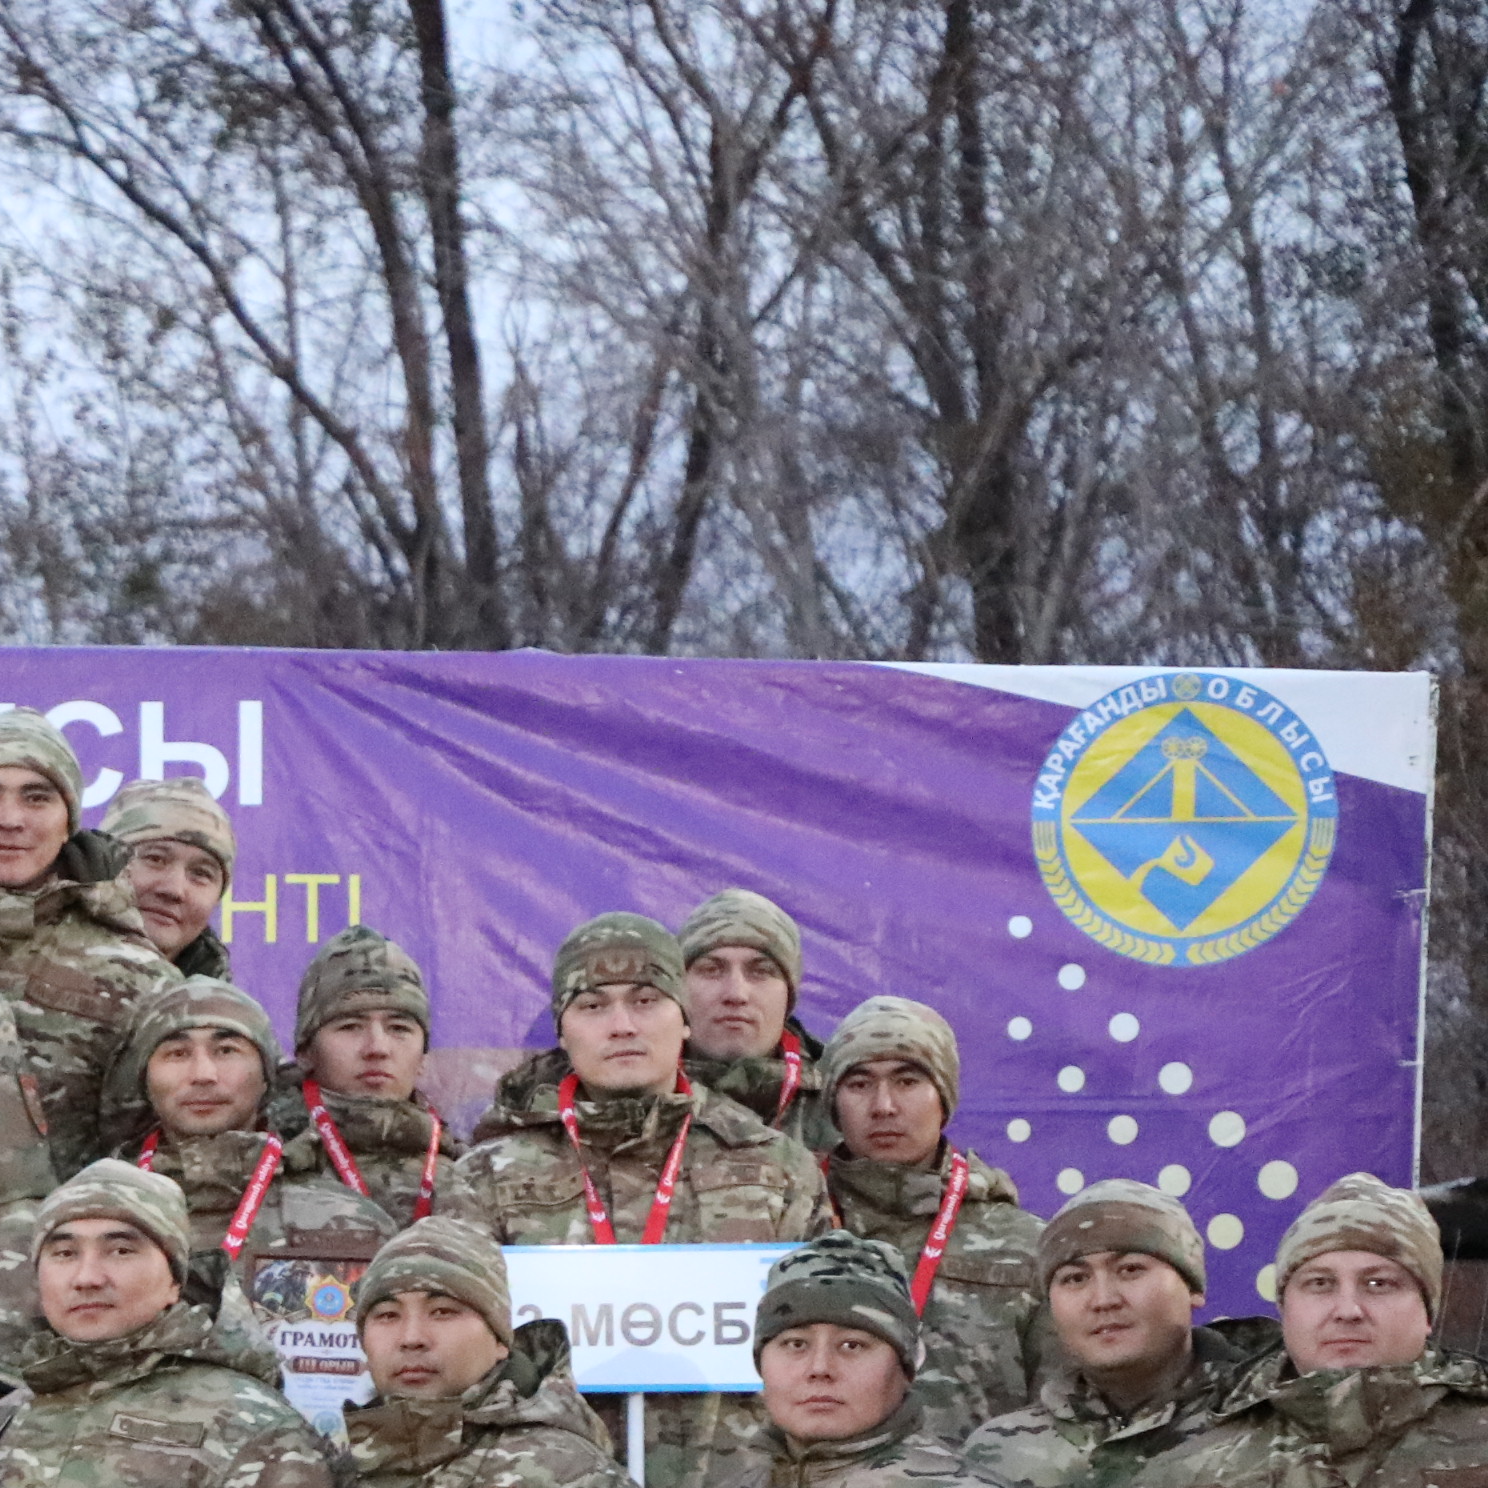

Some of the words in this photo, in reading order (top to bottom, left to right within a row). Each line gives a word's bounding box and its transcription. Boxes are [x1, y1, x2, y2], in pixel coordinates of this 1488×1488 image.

[1031, 677, 1168, 810] ҚАРАҒАНДЫ
[1207, 676, 1334, 804] ОБЛЫСЫ
[280, 1331, 359, 1349] ГРАМОТ
